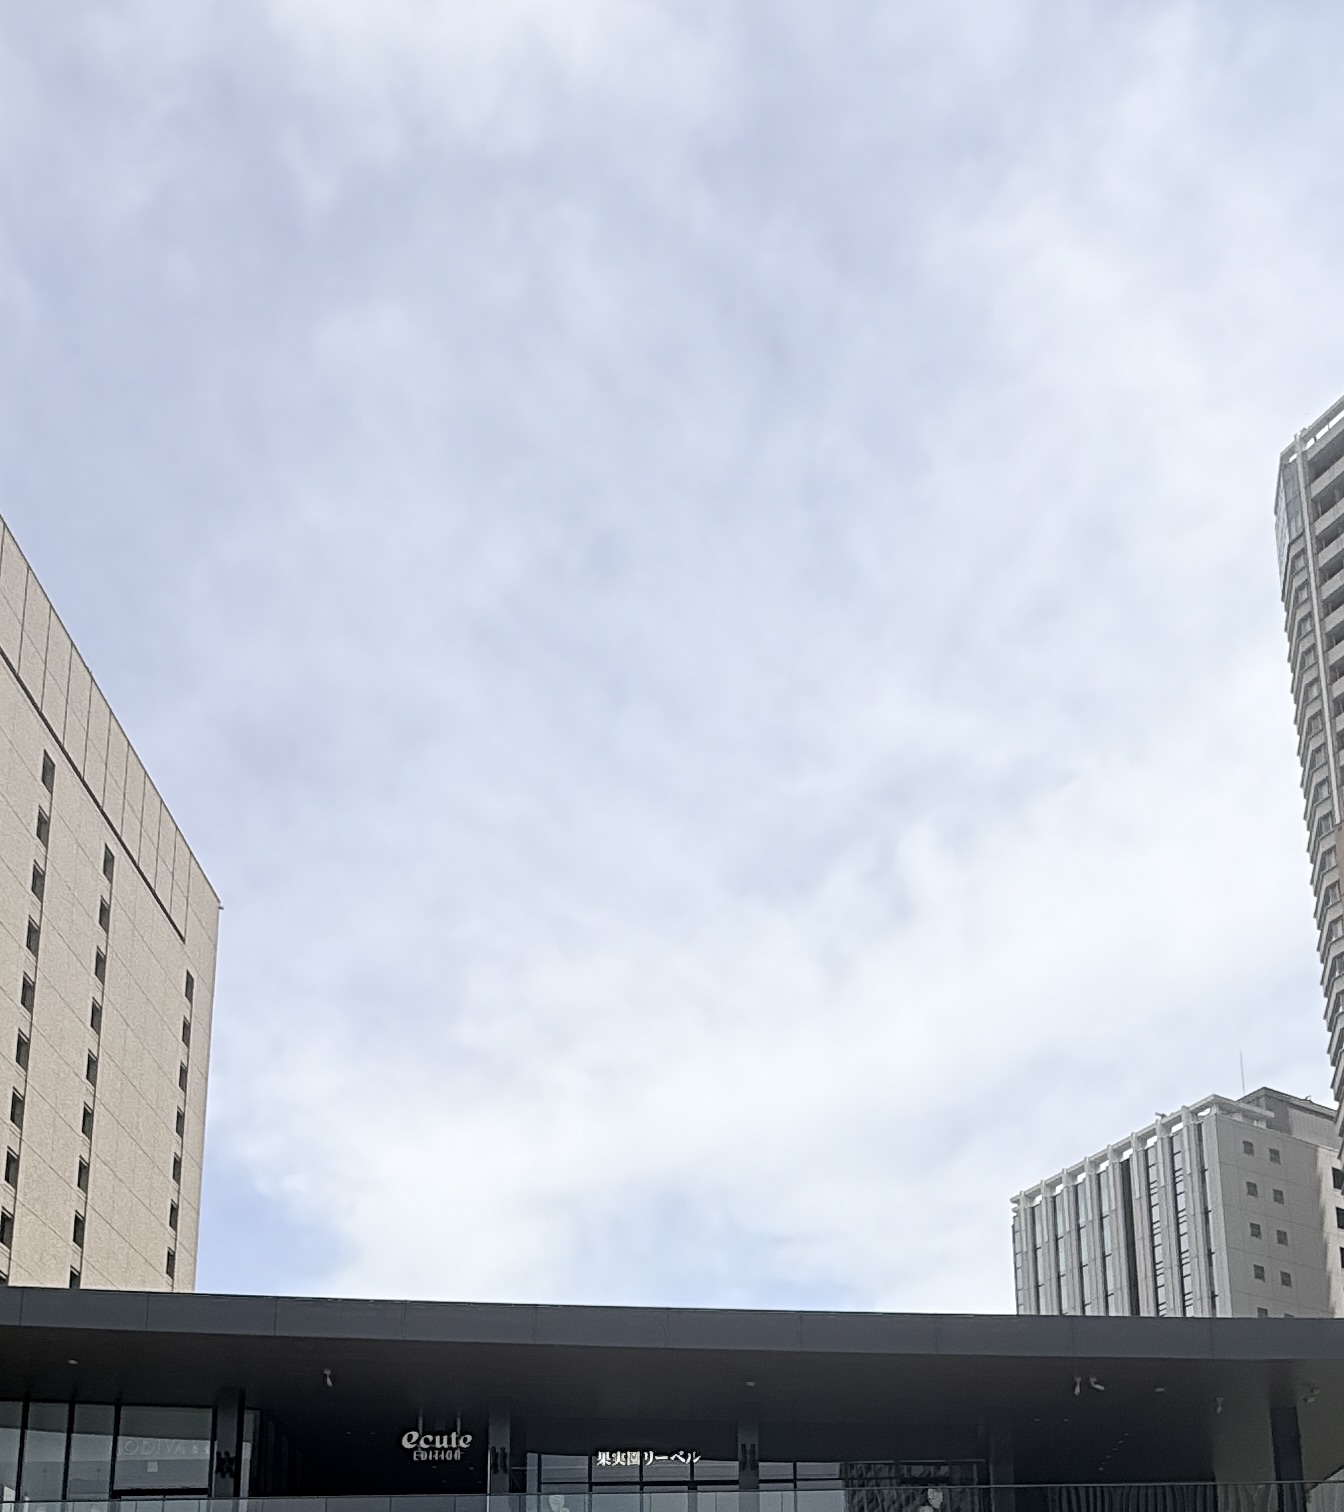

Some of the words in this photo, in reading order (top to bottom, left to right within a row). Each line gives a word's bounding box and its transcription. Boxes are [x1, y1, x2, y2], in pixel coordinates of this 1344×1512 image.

[401, 1431, 473, 1449] ecute
[413, 1450, 461, 1461] EDITION
[596, 1450, 702, 1467] 果実園リーベル
